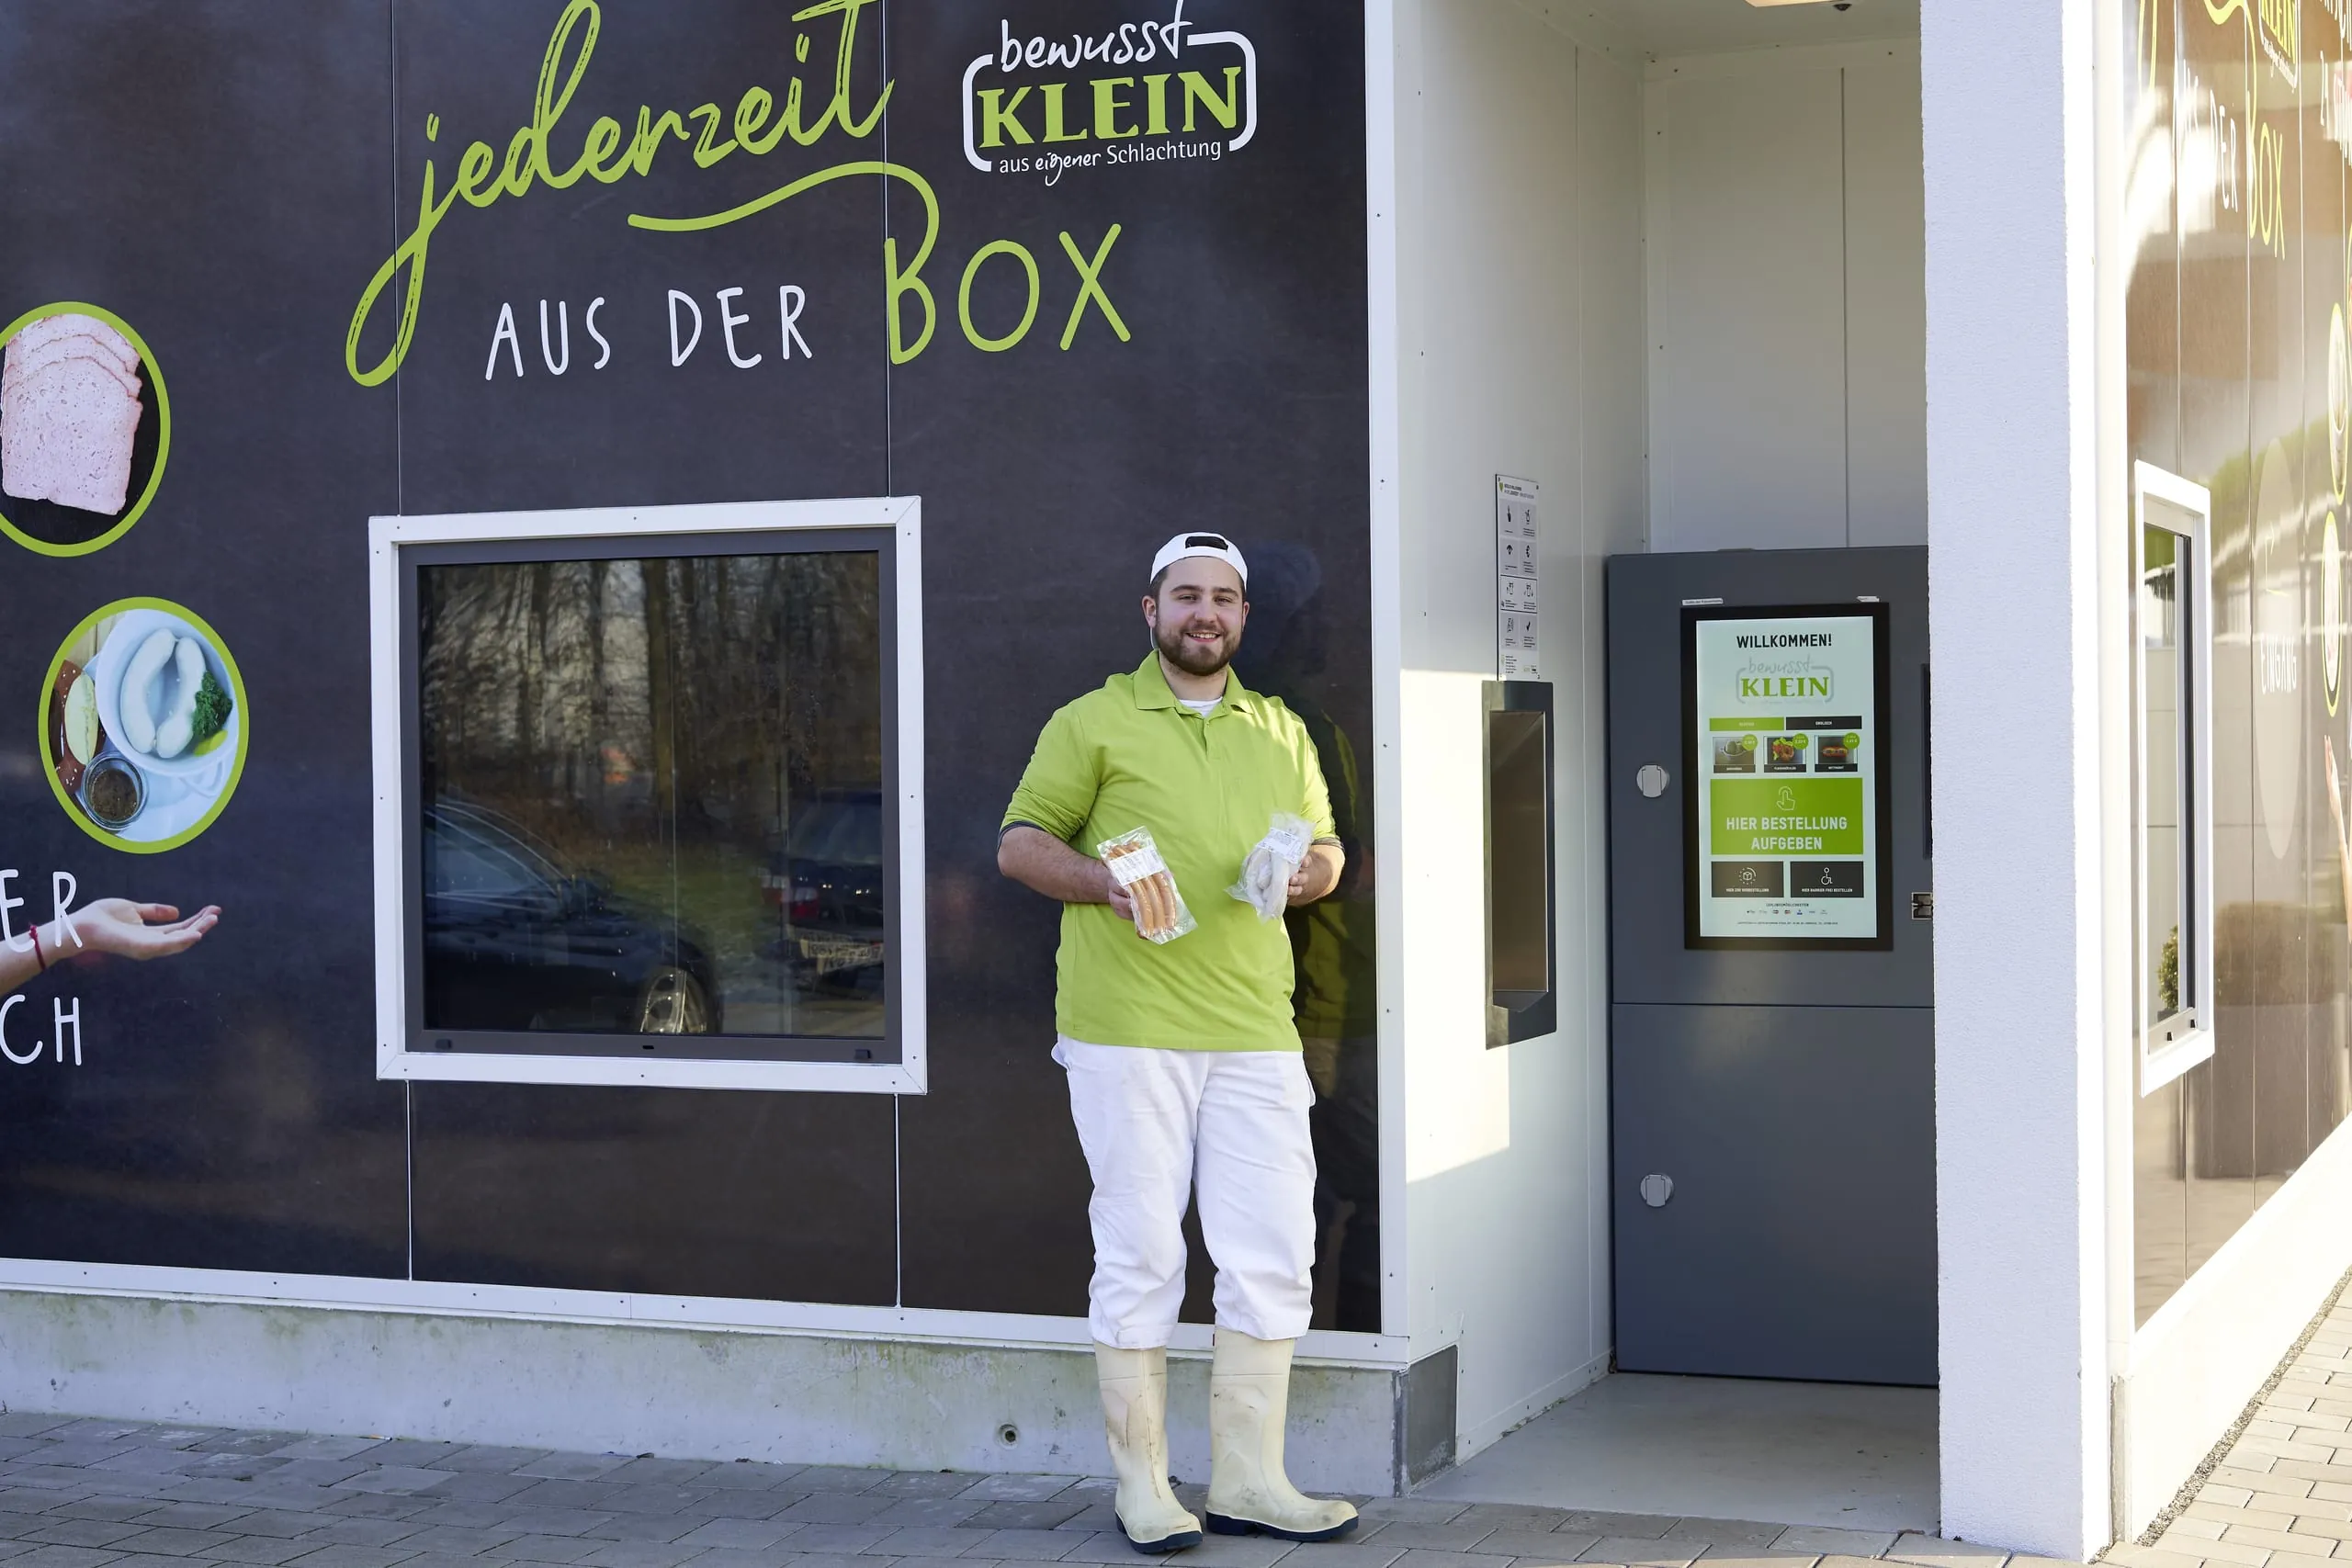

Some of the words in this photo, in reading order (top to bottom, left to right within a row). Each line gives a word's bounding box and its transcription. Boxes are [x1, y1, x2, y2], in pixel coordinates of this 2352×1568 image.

[1001, 0, 1193, 73] bewusst
[977, 66, 1242, 149] KLEIN
[999, 155, 1030, 174] aus
[1035, 151, 1102, 186] eigener
[1106, 141, 1222, 165] Schlachtung
[345, 0, 894, 387] jederzeit
[485, 297, 612, 381] AUS
[668, 285, 814, 369] DER
[875, 160, 1132, 366] BOX
[1736, 634, 1832, 649] WILLKOMMEN!
[1748, 653, 1812, 674] bewusst
[1740, 676, 1829, 697] KLEIN
[2260, 634, 2297, 695] EINGANG
[1726, 817, 1757, 830] HIER
[1761, 817, 1848, 830] BESTELLUNG
[1751, 837, 1823, 851] AUFGEBEN
